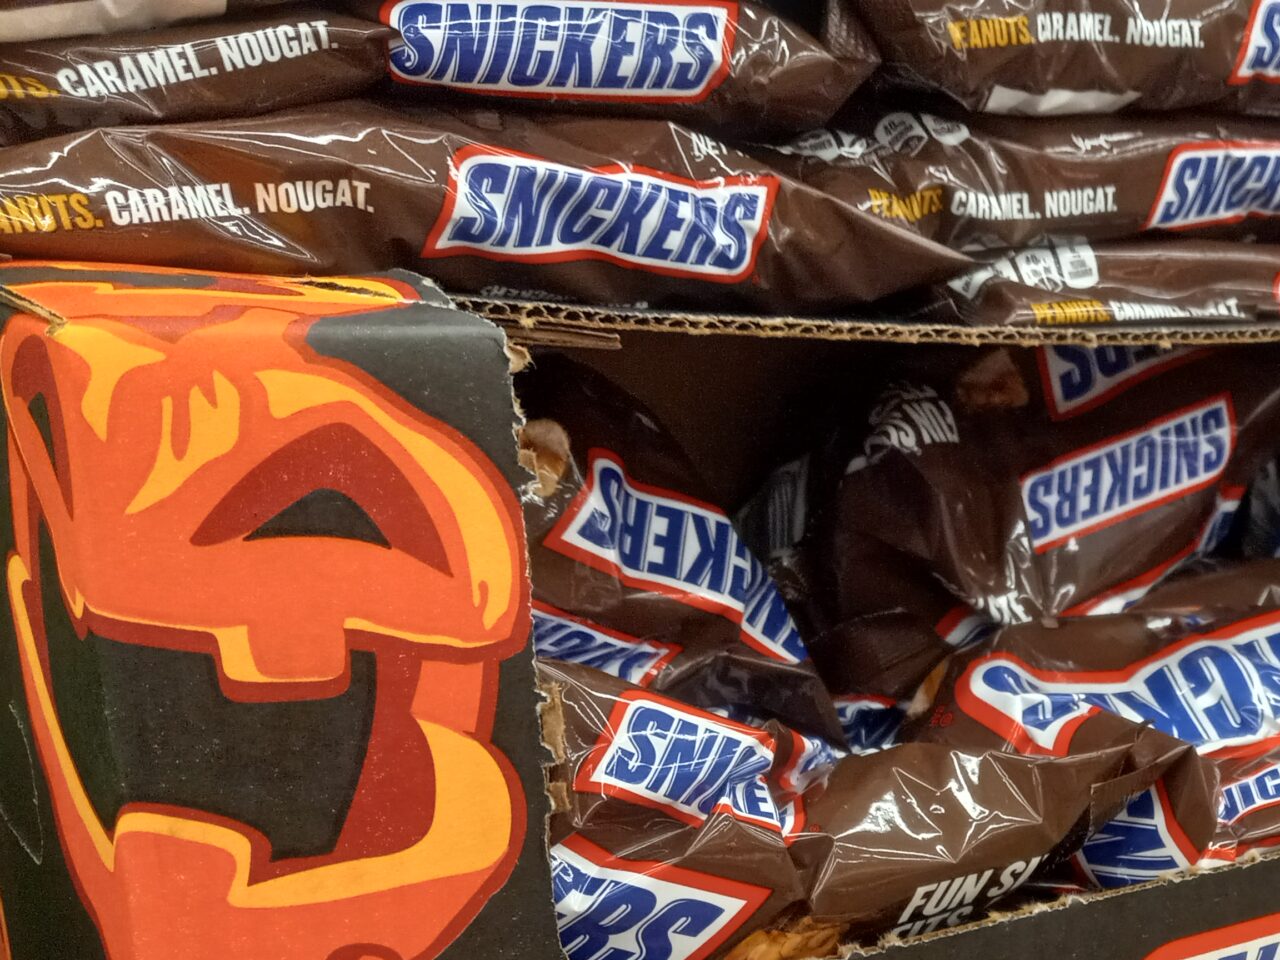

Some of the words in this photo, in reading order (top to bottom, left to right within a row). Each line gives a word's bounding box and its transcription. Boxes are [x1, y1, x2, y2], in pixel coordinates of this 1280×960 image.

[57, 46, 218, 98] CARAMEL.
[215, 20, 339, 73] NOUGAT.
[390, 3, 725, 91] SNICKERS
[1126, 17, 1205, 48] NOUGAT.
[105, 183, 250, 226] CARAMEL.
[255, 179, 374, 213] NOUGAT.
[454, 161, 762, 276] SNICKERS
[950, 190, 1041, 220] CARAMEL.
[1045, 186, 1118, 218] NOUGAT.
[1027, 407, 1228, 540] SNICKERS
[897, 868, 994, 924] FUN
